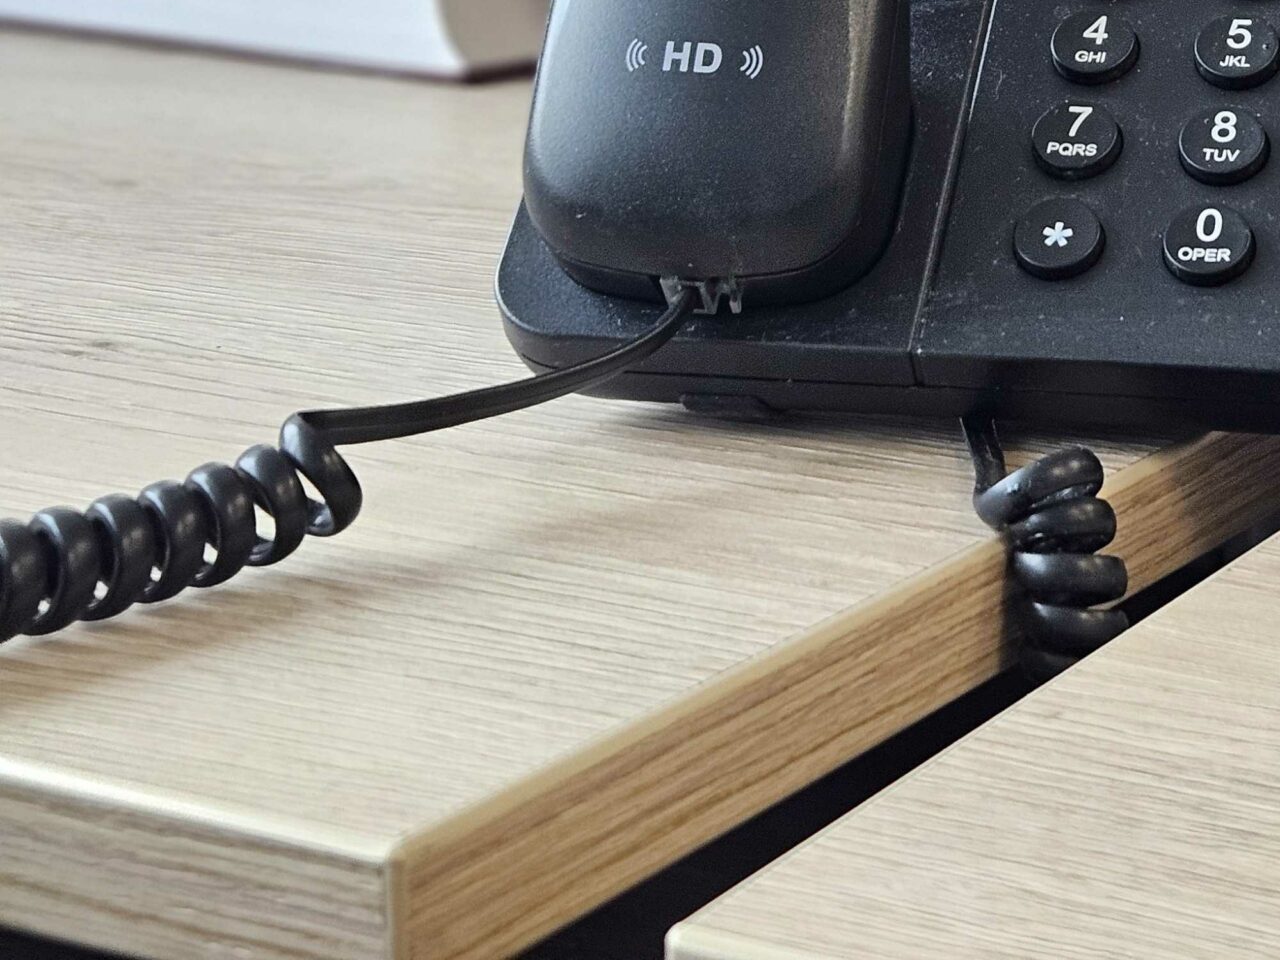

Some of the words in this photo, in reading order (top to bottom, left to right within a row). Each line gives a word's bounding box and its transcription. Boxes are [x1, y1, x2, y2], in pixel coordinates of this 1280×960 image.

[1082, 15, 1109, 45] 4
[1226, 18, 1253, 49] 5
[661, 40, 723, 74] HD
[1074, 50, 1107, 64] GHI
[1219, 54, 1251, 68] JKL
[1068, 105, 1094, 137] 7
[1210, 110, 1238, 143] 8
[1046, 141, 1098, 157] PQRS
[1202, 147, 1241, 162] TUV
[1196, 208, 1223, 243] 0
[1177, 246, 1232, 263] OPER
